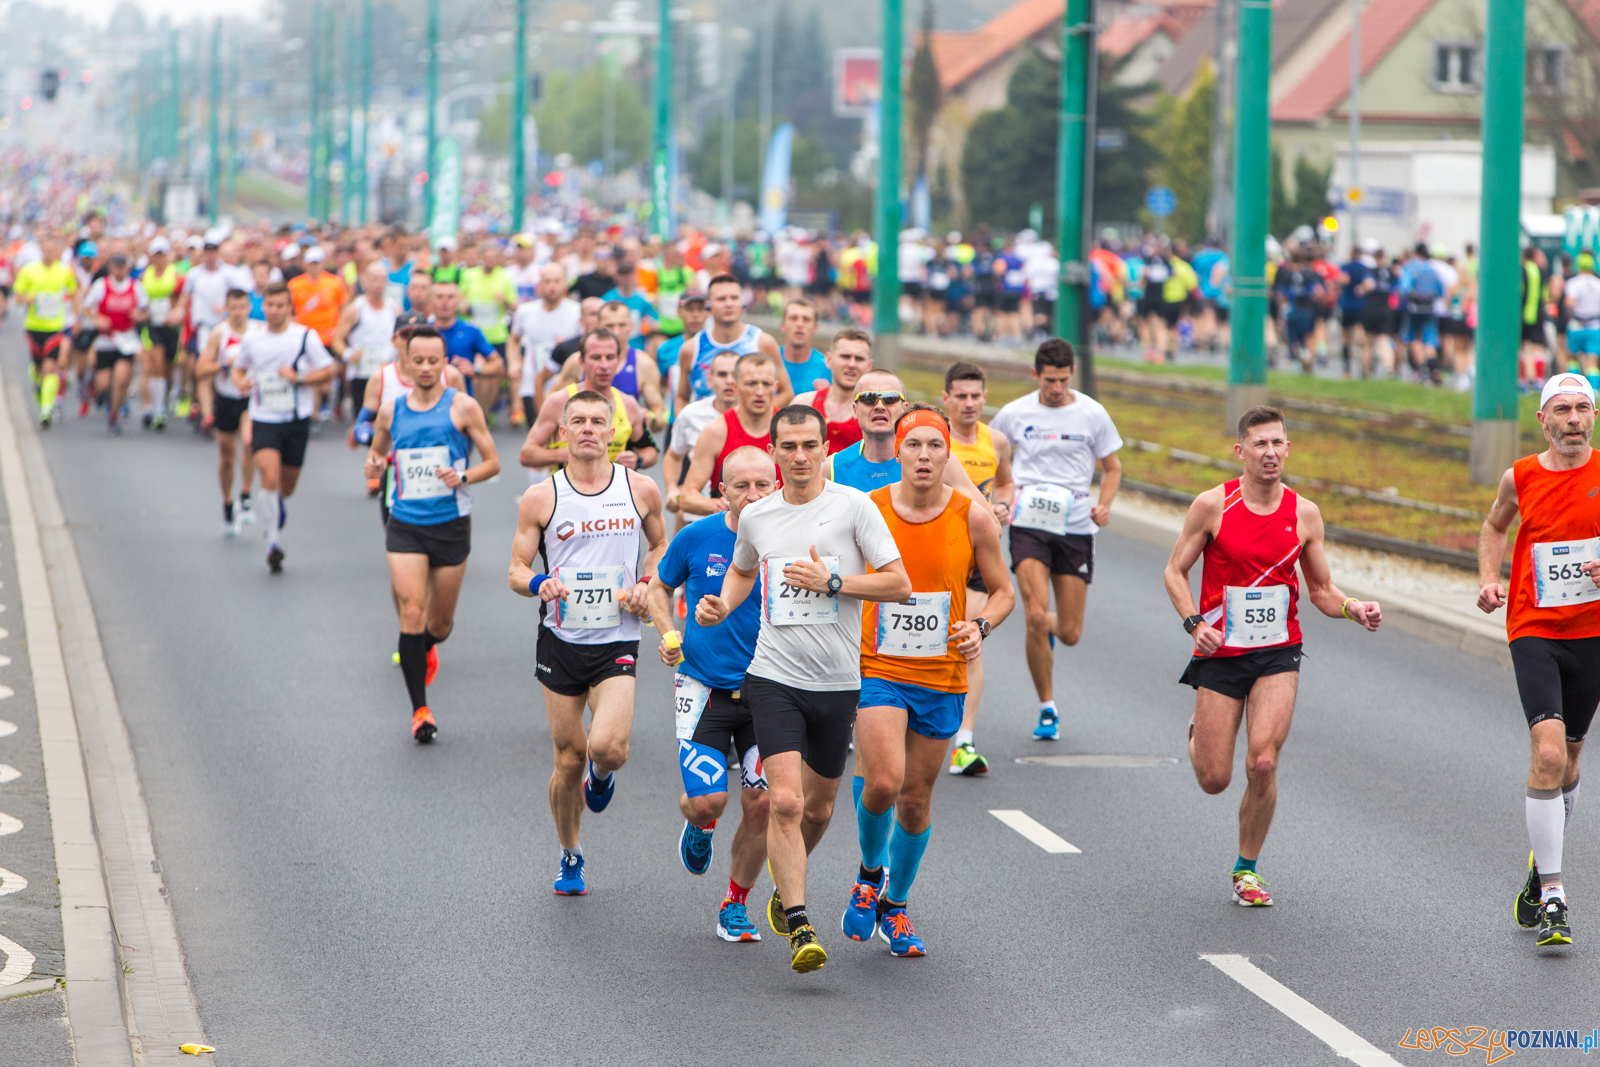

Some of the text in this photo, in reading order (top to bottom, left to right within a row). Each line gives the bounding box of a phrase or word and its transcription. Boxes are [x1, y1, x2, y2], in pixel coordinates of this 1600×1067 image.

[1029, 496, 1061, 513] 3515
[581, 518, 635, 533] KGHM
[573, 588, 612, 604] 7371
[891, 613, 939, 631] 7380
[1244, 607, 1276, 624] 538
